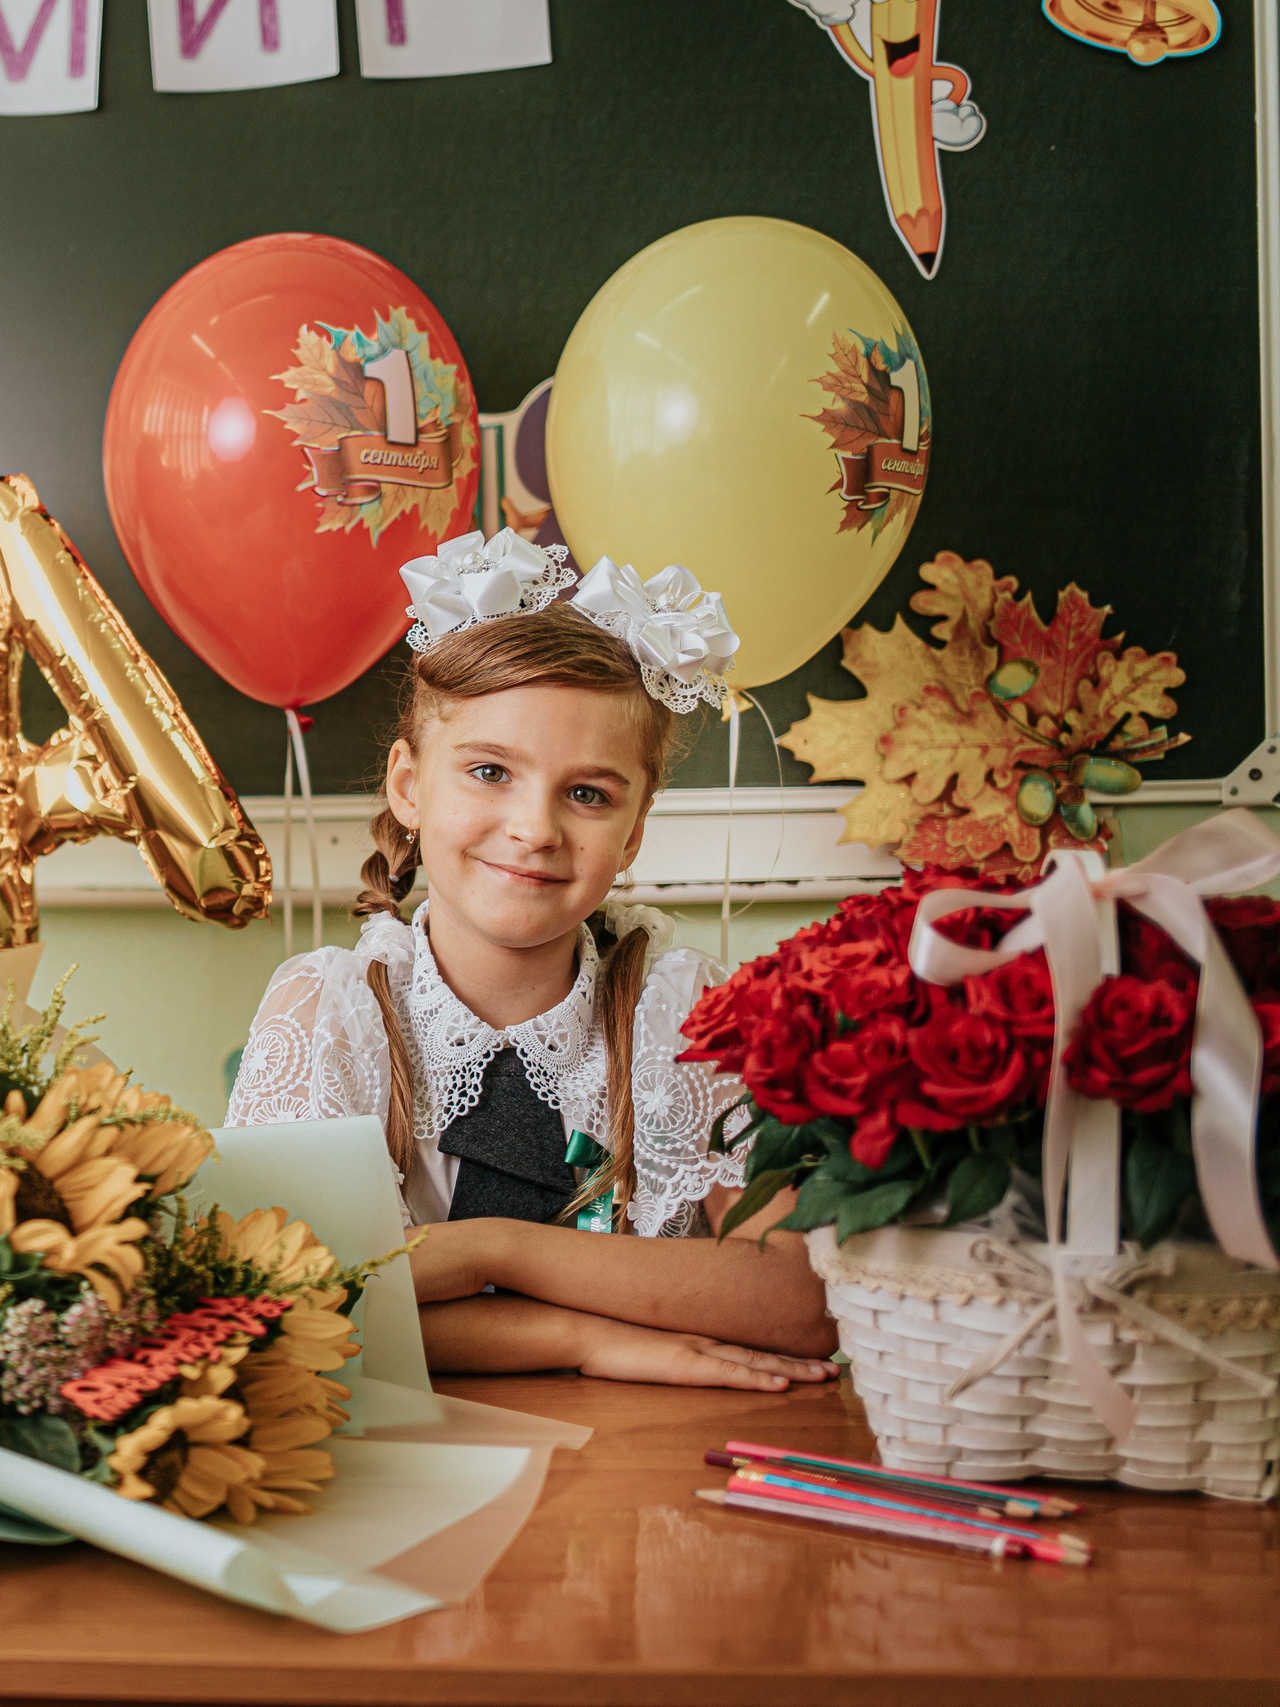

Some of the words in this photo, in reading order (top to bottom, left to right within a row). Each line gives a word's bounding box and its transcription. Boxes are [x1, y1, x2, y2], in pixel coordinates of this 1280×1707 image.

[363, 348, 418, 446] 1
[889, 358, 920, 452] 1
[360, 448, 439, 474] сентября
